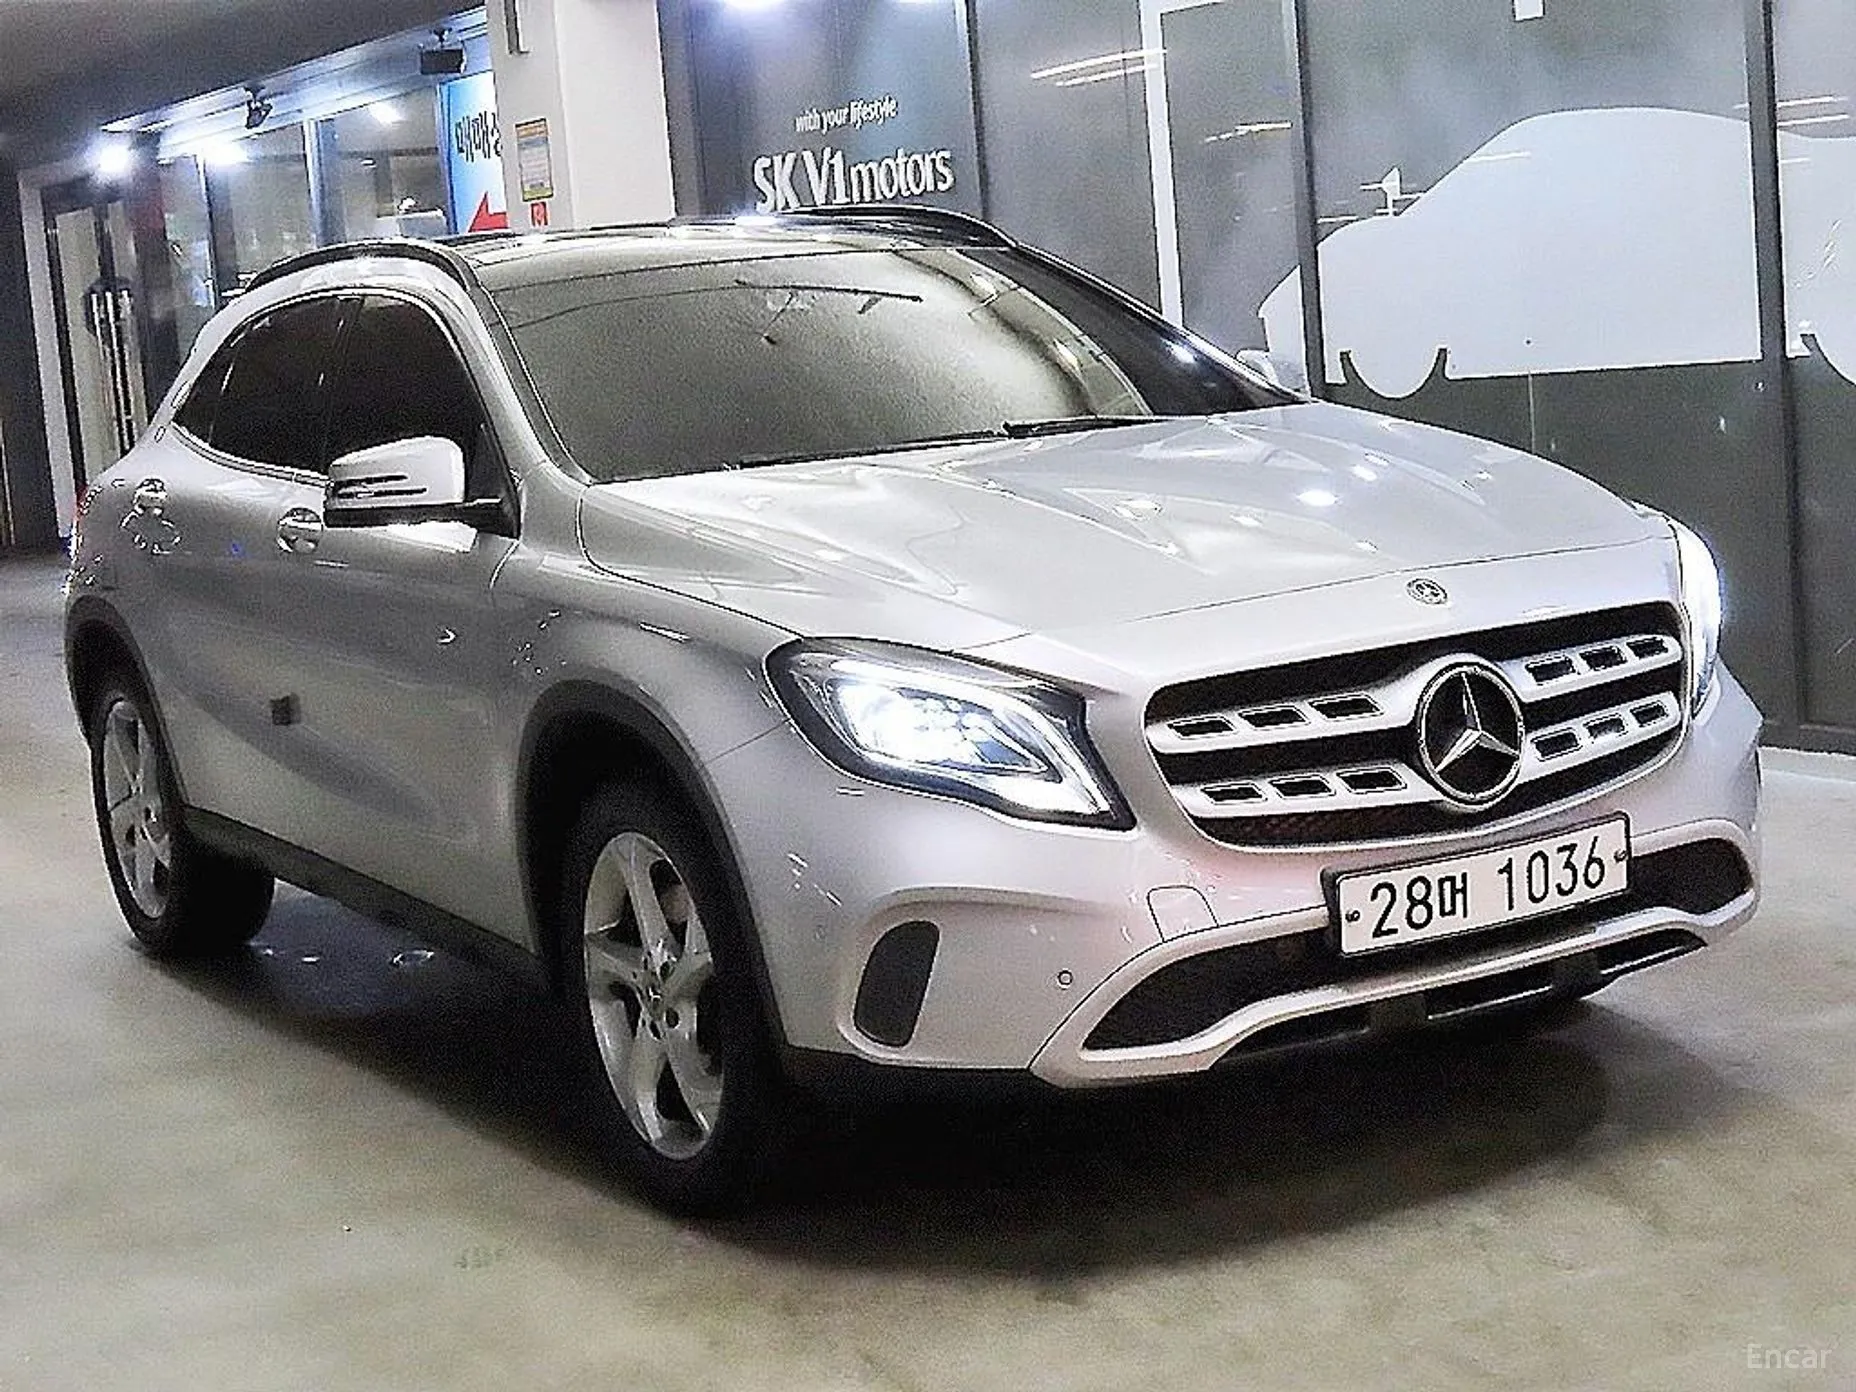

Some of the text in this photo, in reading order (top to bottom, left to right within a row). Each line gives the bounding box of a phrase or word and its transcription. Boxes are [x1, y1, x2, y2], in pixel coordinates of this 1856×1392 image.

[795, 94, 897, 135] with your lifestyle
[753, 152, 800, 213] SK
[1370, 836, 1606, 939] 28머 1036
